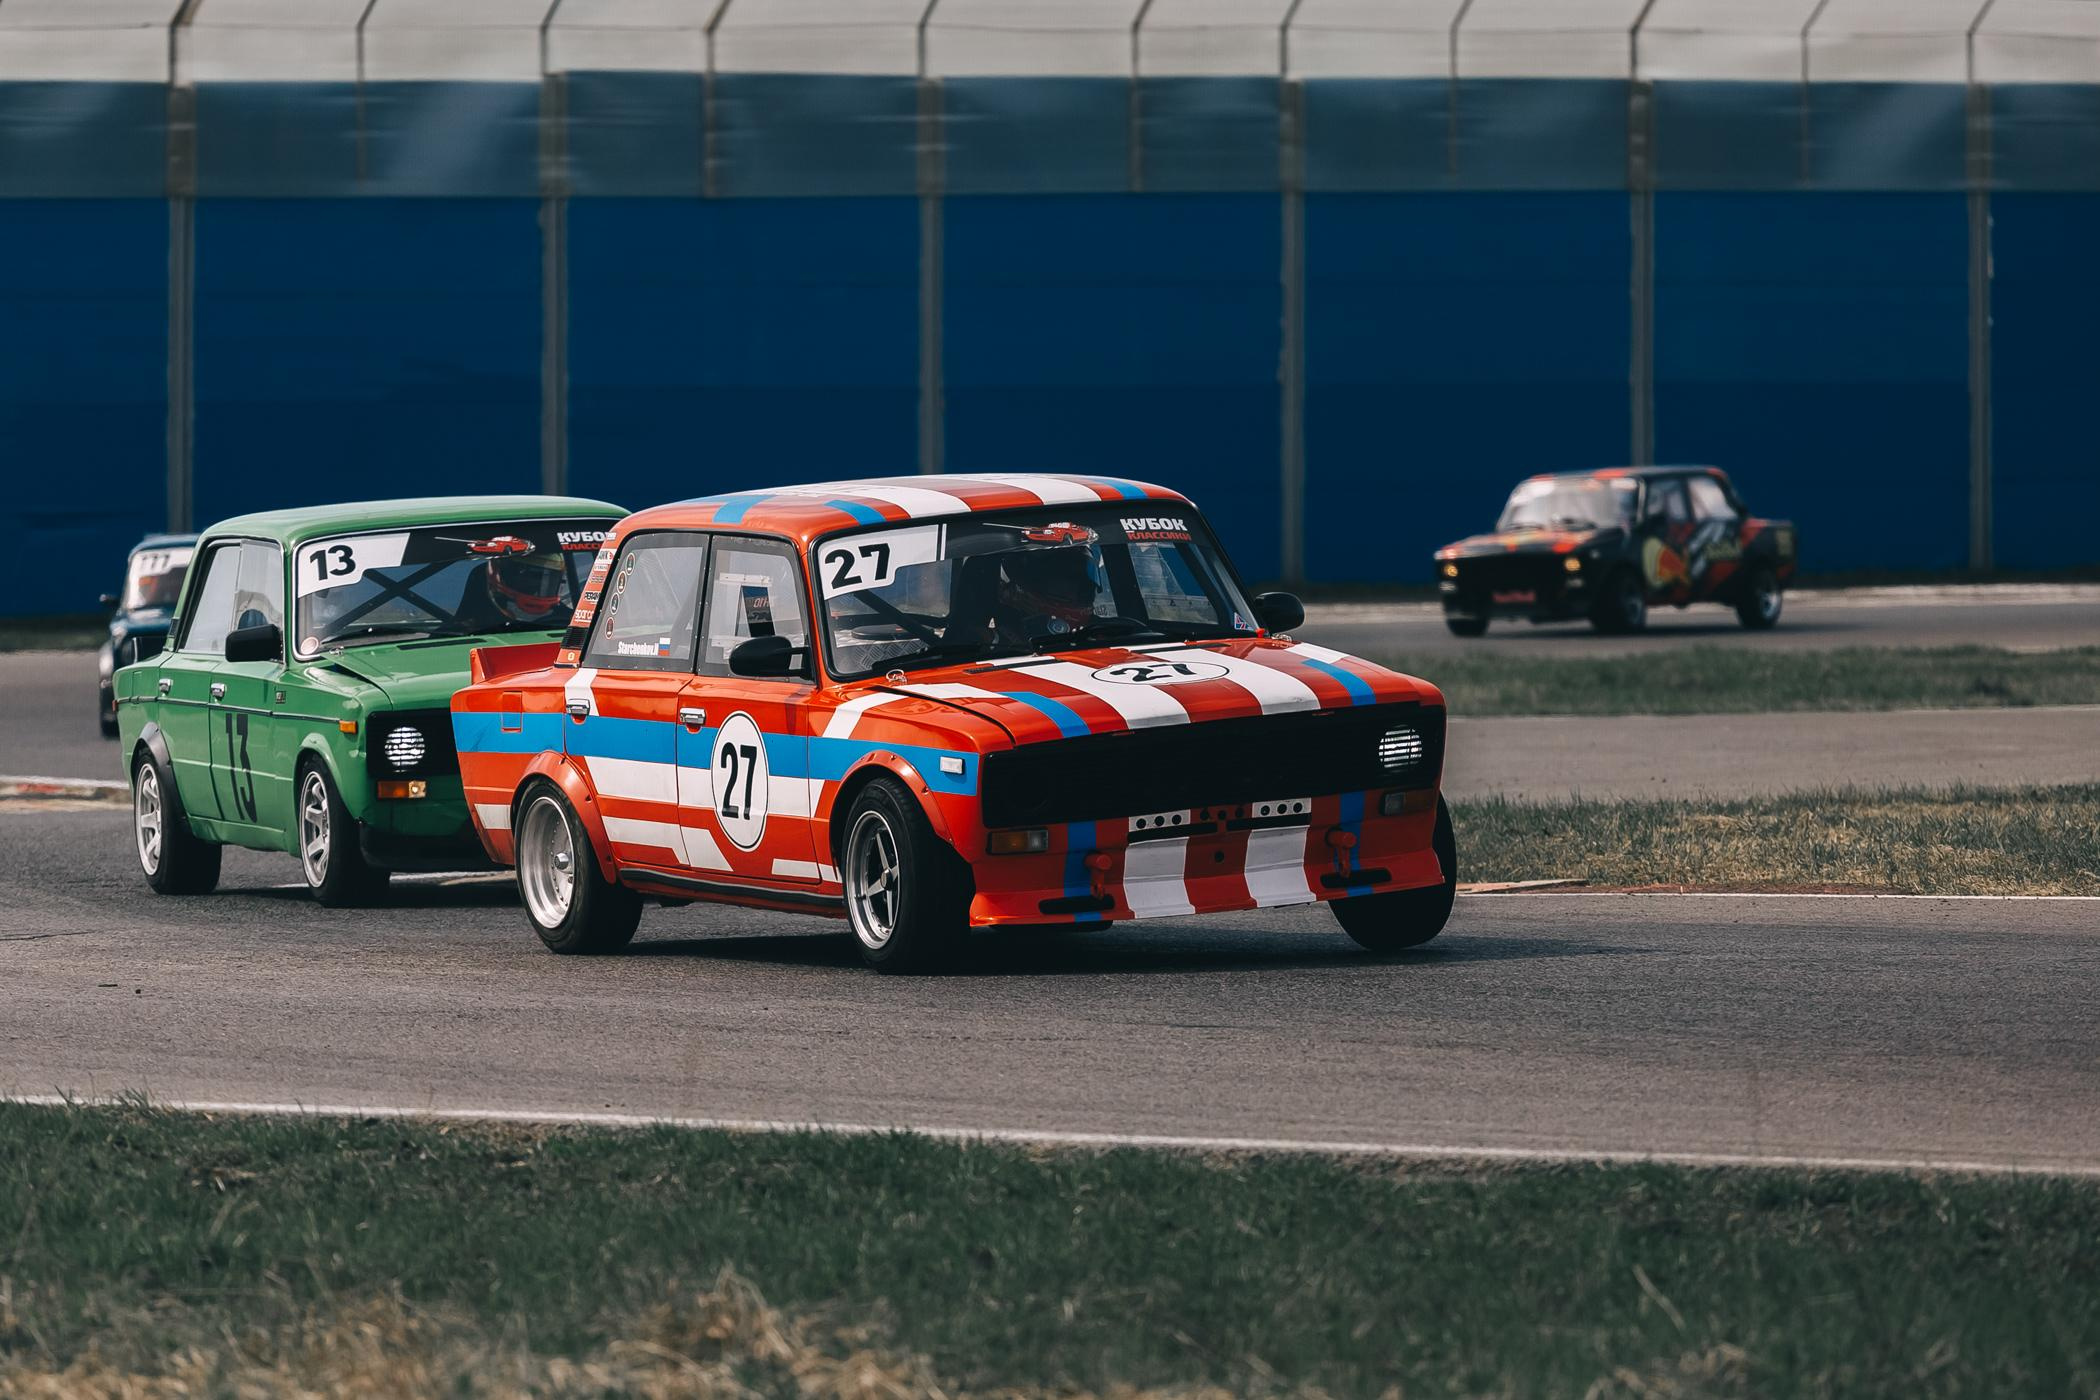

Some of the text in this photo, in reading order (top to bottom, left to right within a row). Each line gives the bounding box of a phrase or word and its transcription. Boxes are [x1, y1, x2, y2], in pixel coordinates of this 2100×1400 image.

[1120, 518, 1188, 531] КУБОК
[1127, 531, 1192, 540] КЛАССИКИ
[310, 545, 356, 581] 13
[825, 543, 890, 589] 27
[1110, 663, 1197, 682] 27
[225, 713, 257, 823] 13
[721, 742, 757, 820] 27
